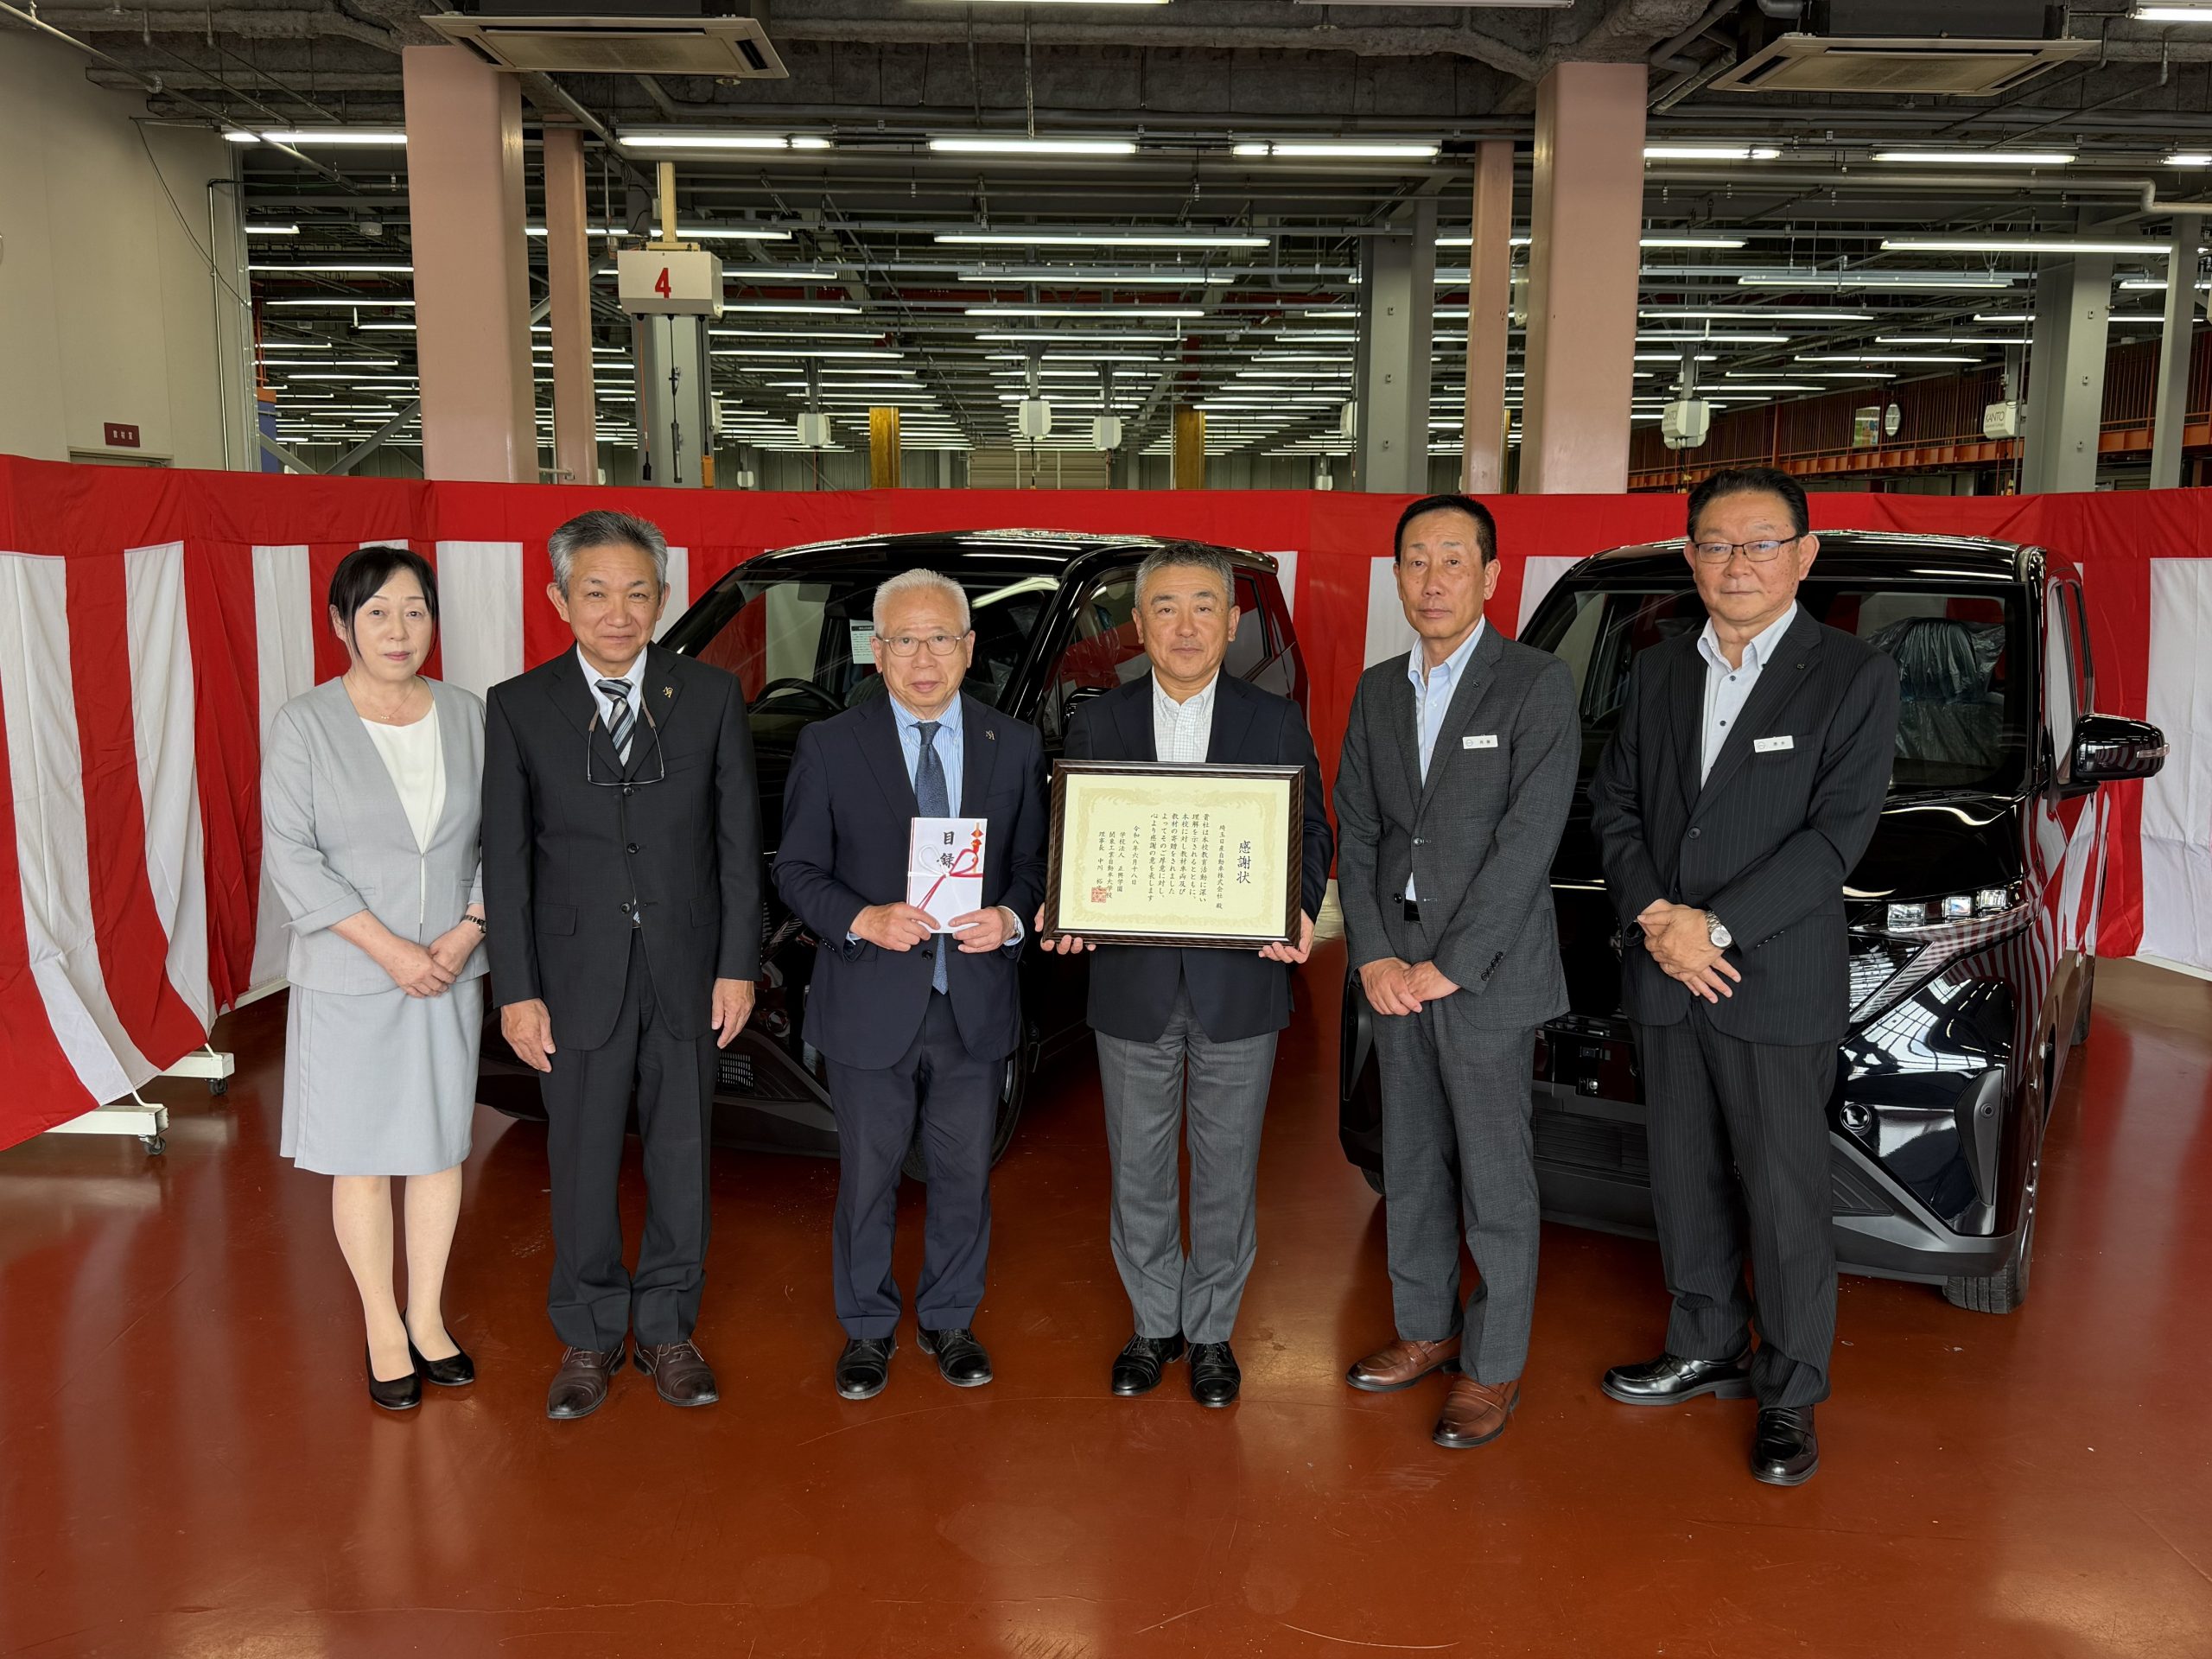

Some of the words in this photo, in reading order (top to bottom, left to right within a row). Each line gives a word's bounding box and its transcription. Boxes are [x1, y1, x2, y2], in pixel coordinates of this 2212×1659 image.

[655, 267, 671, 299] 4
[1985, 410, 2005, 423] KANTO
[938, 831, 955, 868] 目録
[1106, 831, 1116, 899] 関東工業自動車大学校
[1147, 813, 1158, 902] 心より感謝の意を表します
[1168, 813, 1179, 894] 教材の寄贈をされました
[1179, 813, 1189, 895] 本校に対し教材車両及び
[1217, 824, 1225, 899] 埼玉日産自動車株式会社
[1236, 840, 1251, 884] 感謝状
